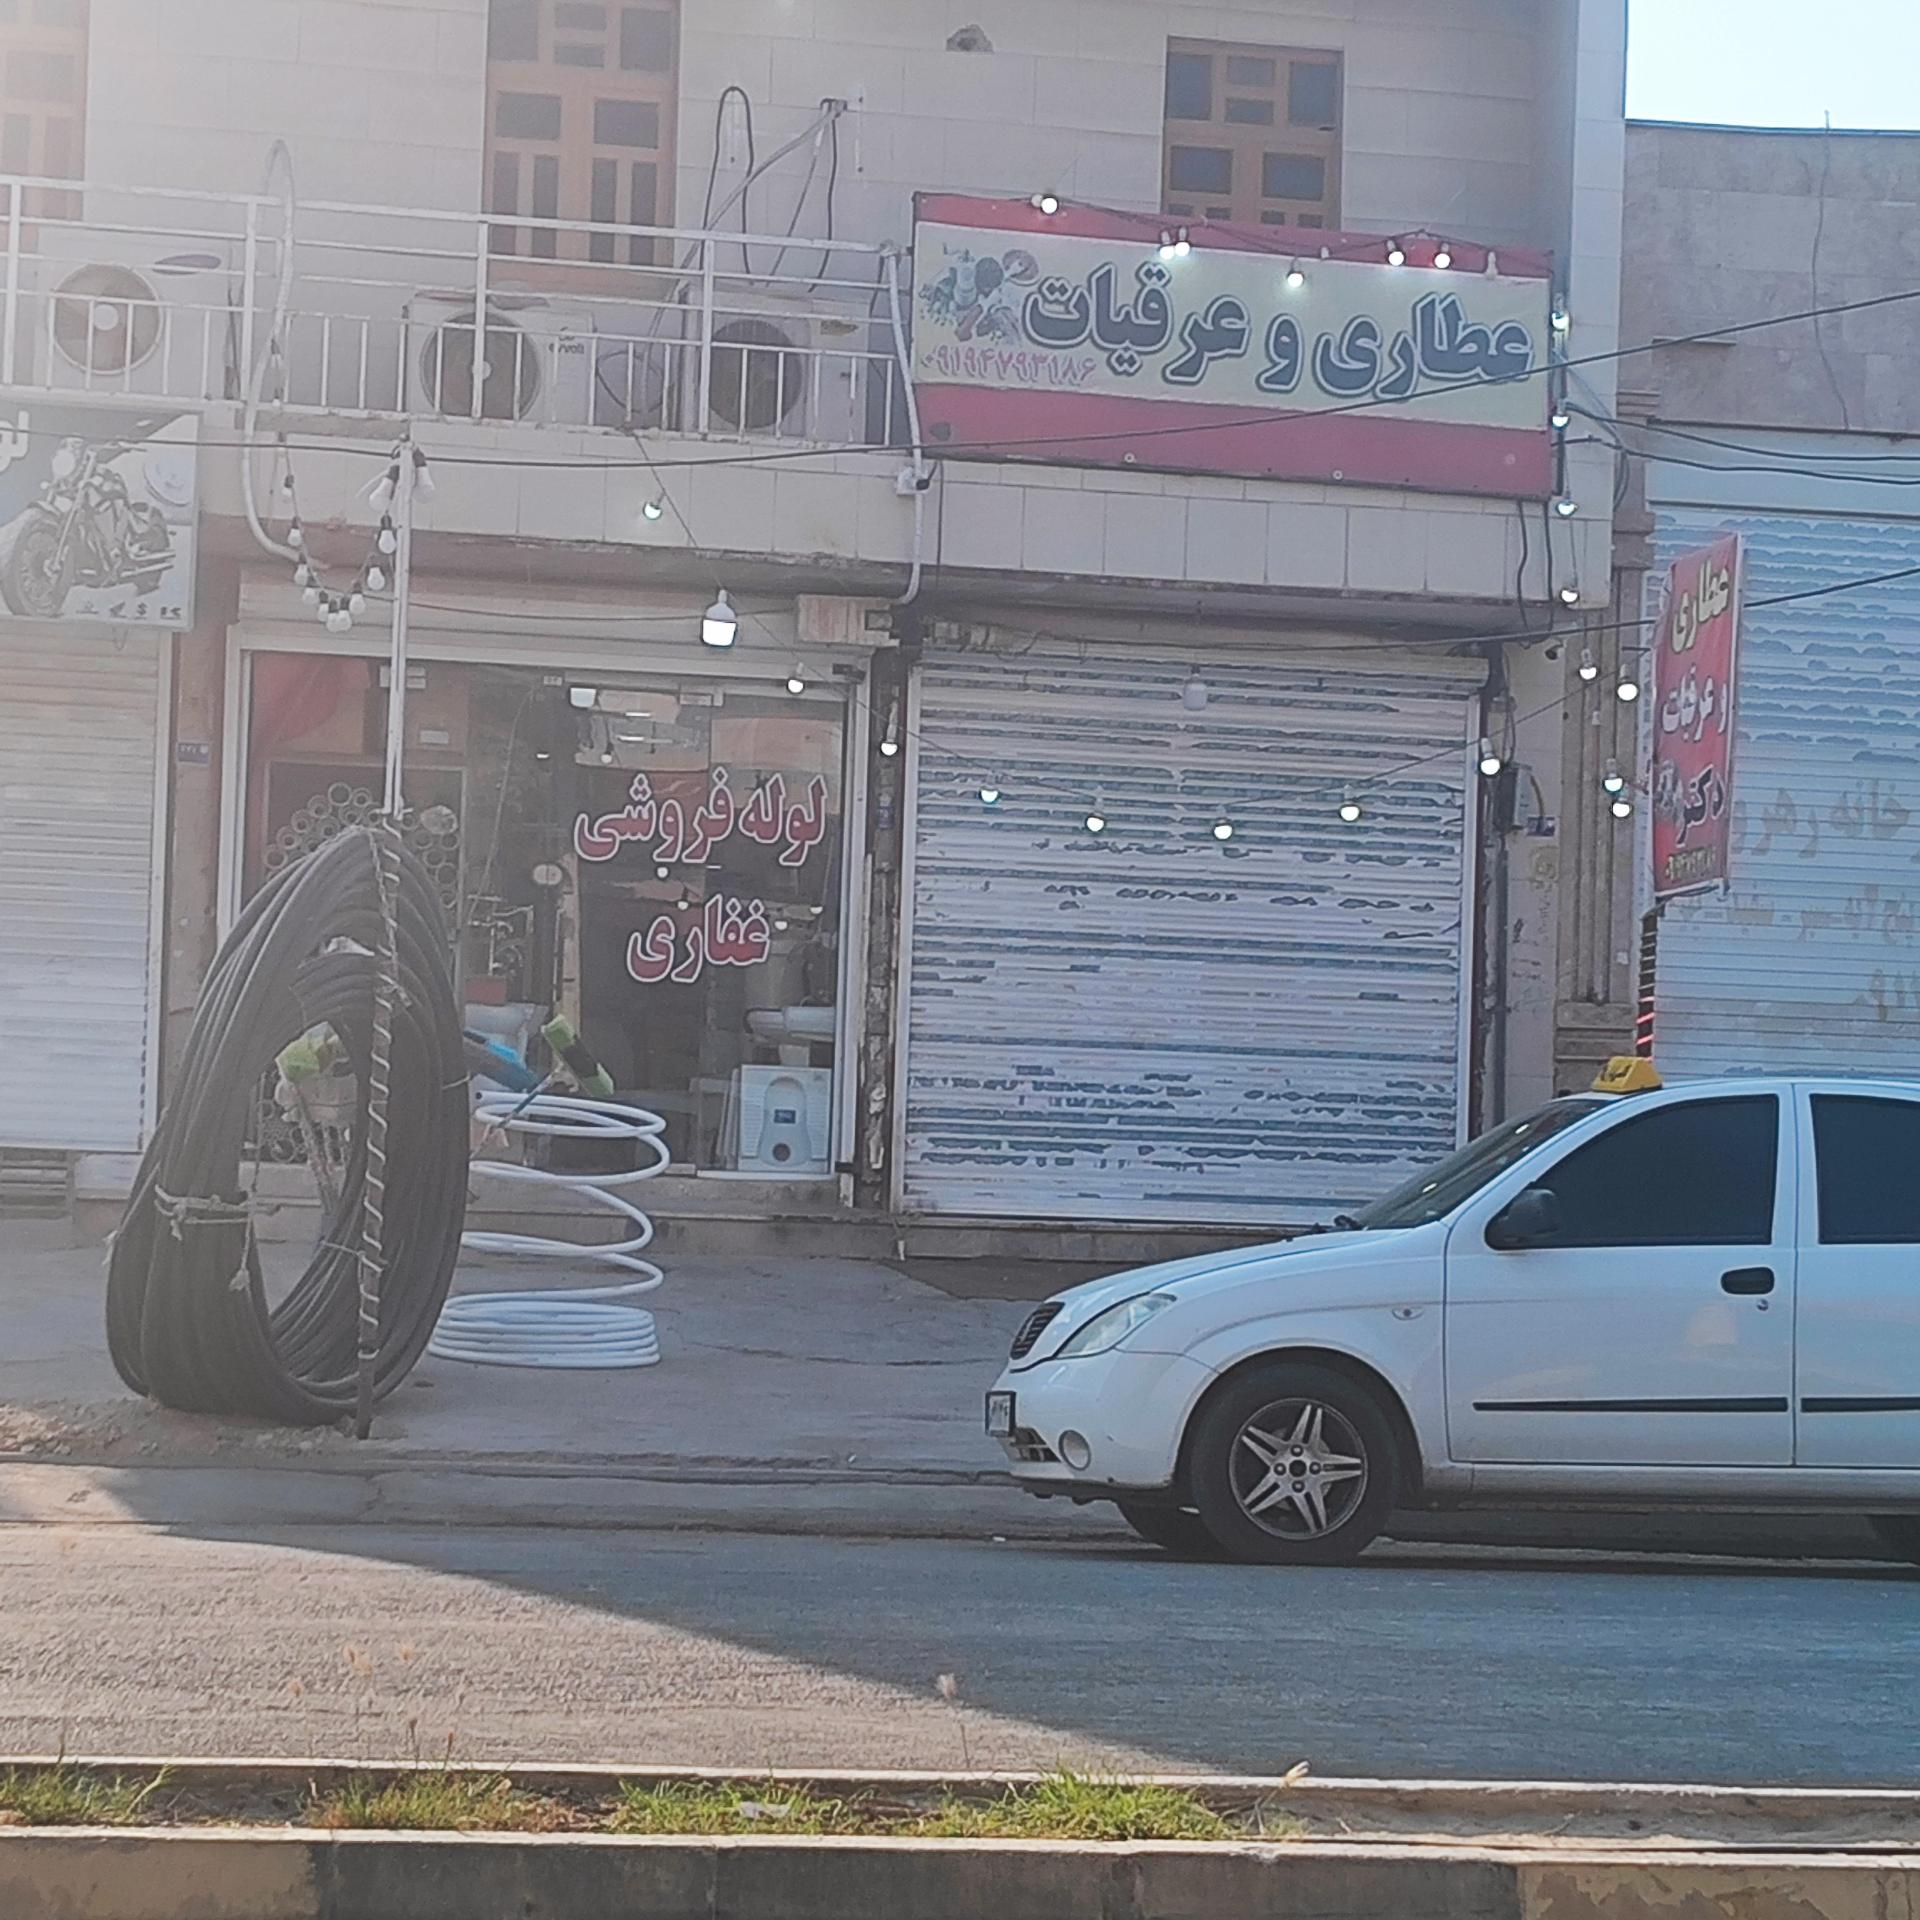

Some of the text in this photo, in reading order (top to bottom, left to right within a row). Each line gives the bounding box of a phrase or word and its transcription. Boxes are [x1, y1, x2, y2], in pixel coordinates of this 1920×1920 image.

[1022, 262, 1535, 399] عطاری و عرقیات
[1672, 559, 1729, 654] عطاری
[1662, 662, 1714, 743] عرقیات
[574, 766, 828, 867] لوله فروشی
[1676, 763, 1725, 849] دکتر
[627, 894, 771, 984] غفاری
